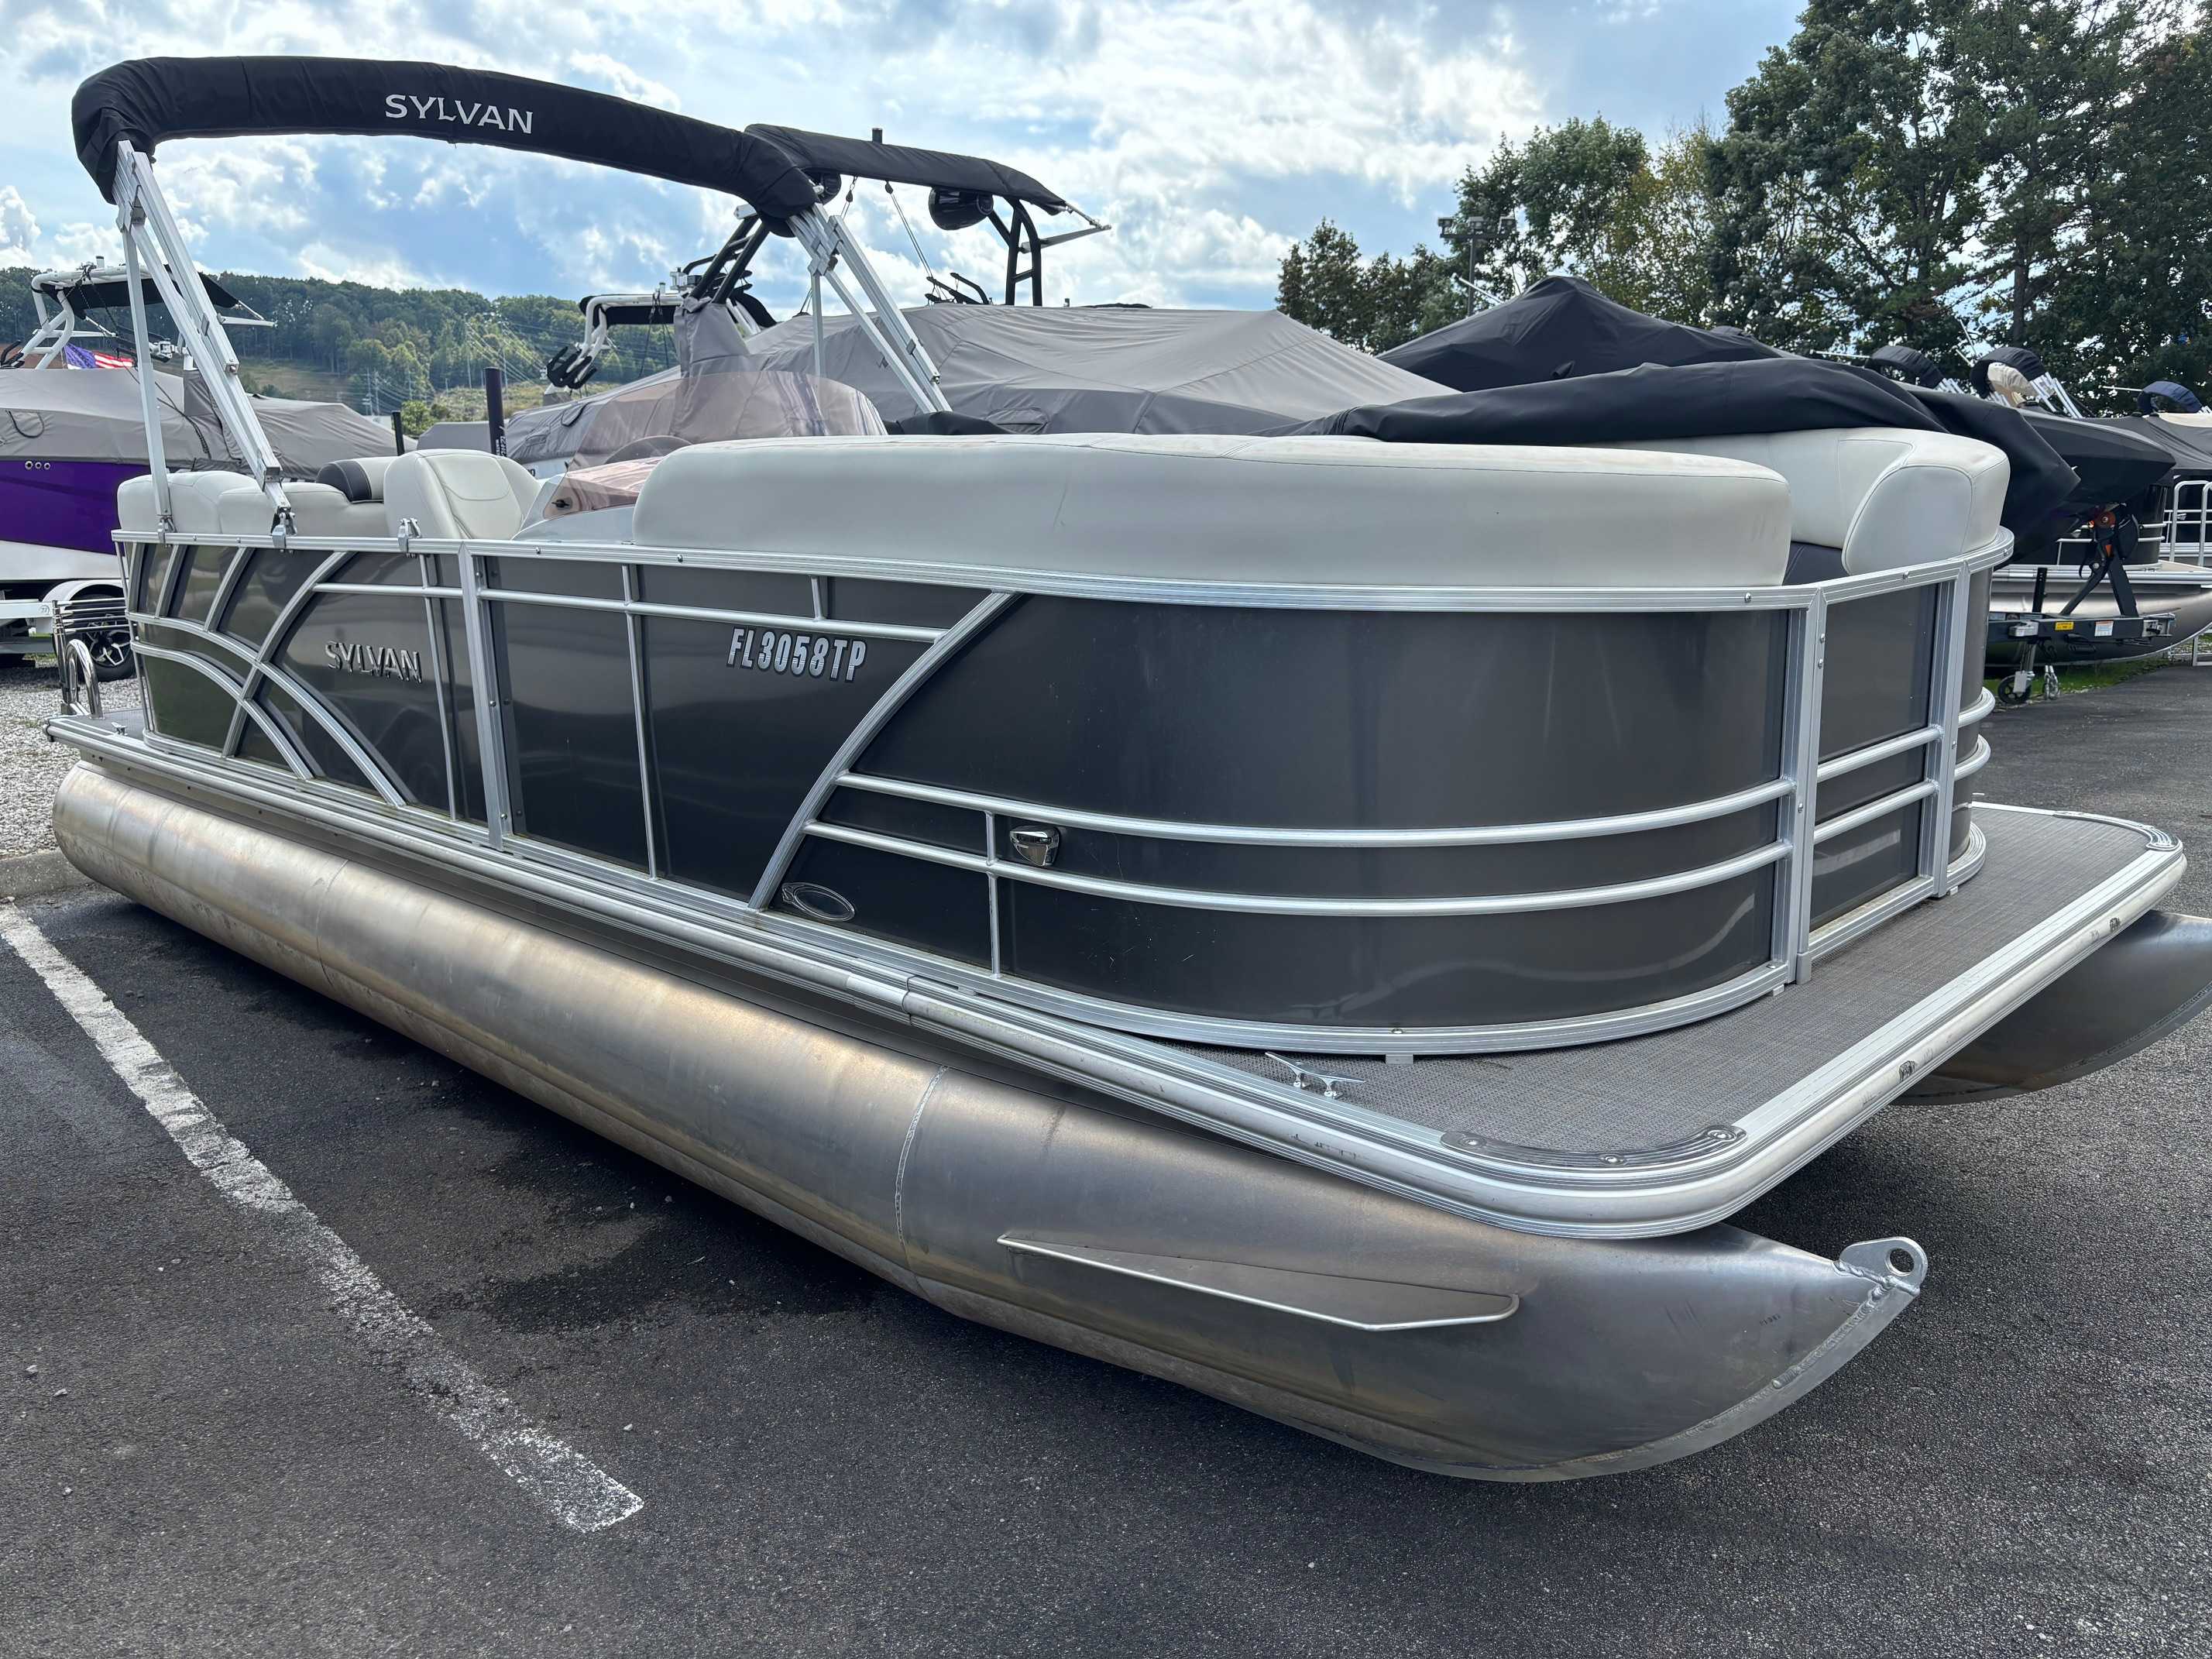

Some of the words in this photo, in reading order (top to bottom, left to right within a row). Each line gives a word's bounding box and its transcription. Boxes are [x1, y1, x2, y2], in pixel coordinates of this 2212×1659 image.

[385, 94, 534, 133] SYLVAN
[325, 640, 423, 684] SYLVAN
[726, 627, 867, 682] FL3058TP
